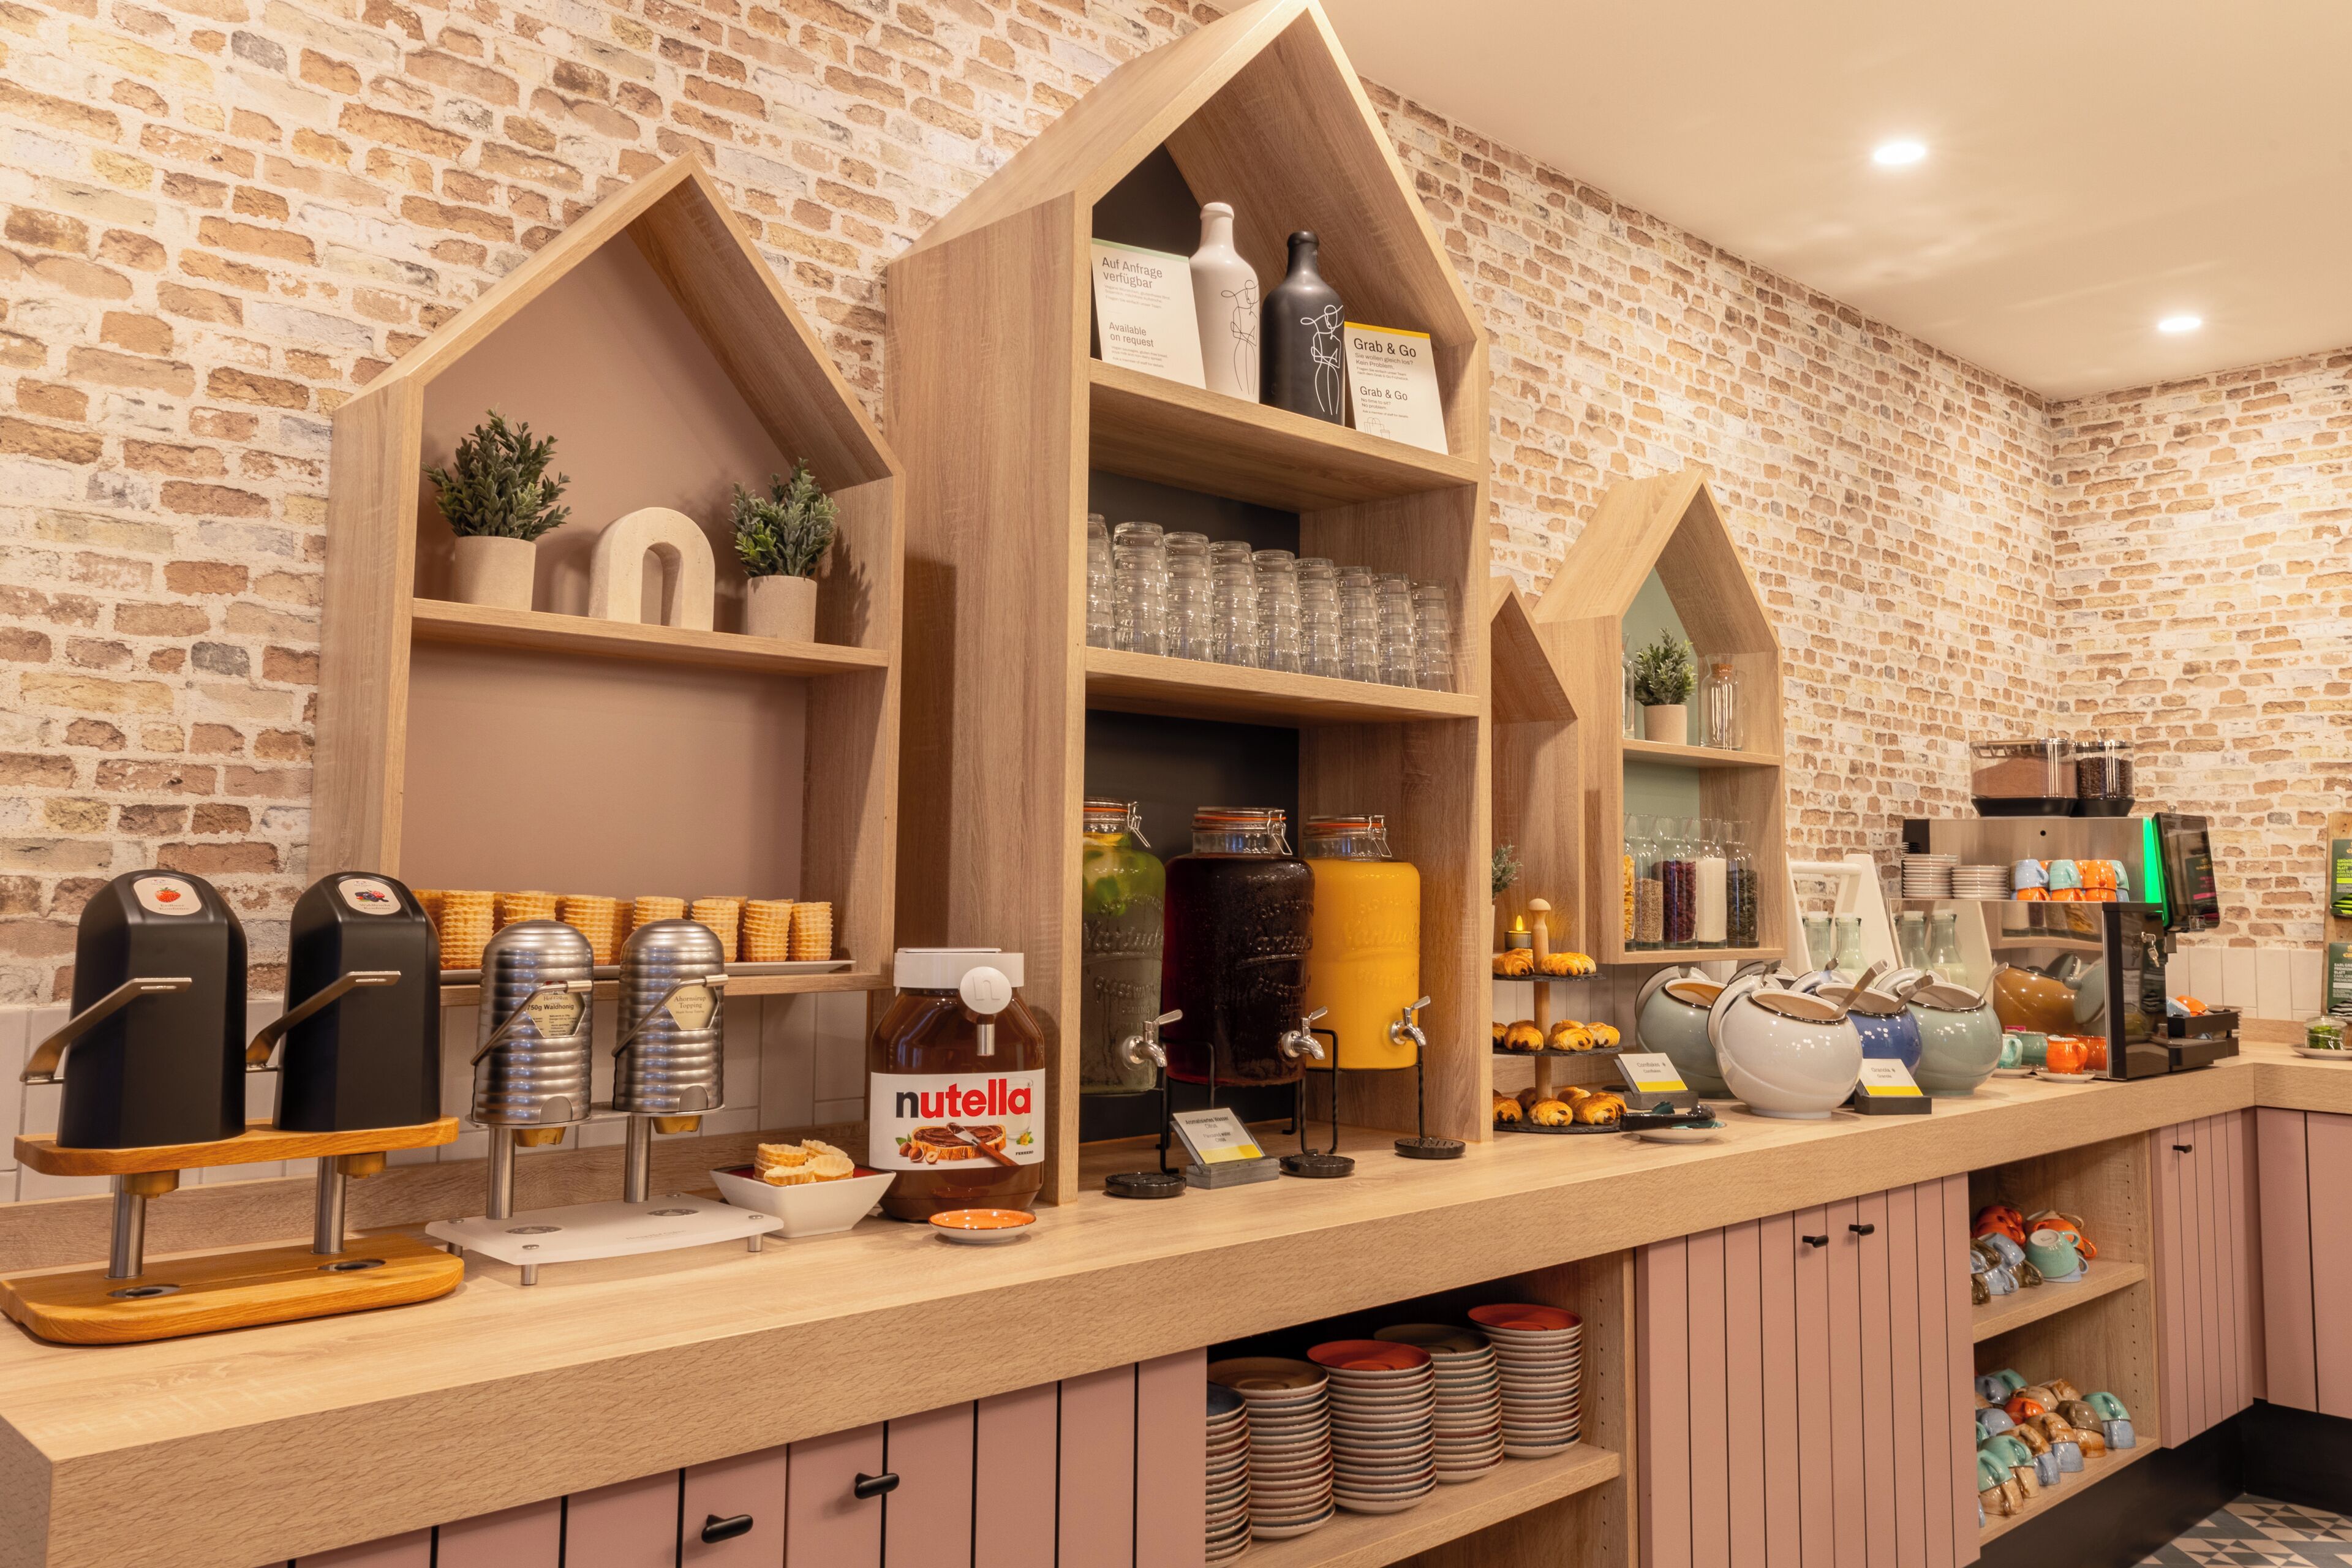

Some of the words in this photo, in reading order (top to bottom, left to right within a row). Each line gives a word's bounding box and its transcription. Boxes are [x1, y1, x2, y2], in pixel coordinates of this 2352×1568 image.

[1102, 257, 1120, 270] Auf
[1122, 261, 1163, 279] Anfrage
[1103, 271, 1153, 288] verfügbar
[1109, 322, 1147, 336] Available
[1110, 333, 1120, 342] on
[1123, 335, 1154, 347] request
[1354, 337, 1382, 353] Grab
[1387, 342, 1396, 355] &
[1399, 344, 1416, 357] Go
[1360, 386, 1382, 398] Grab
[1385, 389, 1392, 399] &
[1394, 391, 1408, 401] Go
[895, 1078, 1031, 1118] nutella
